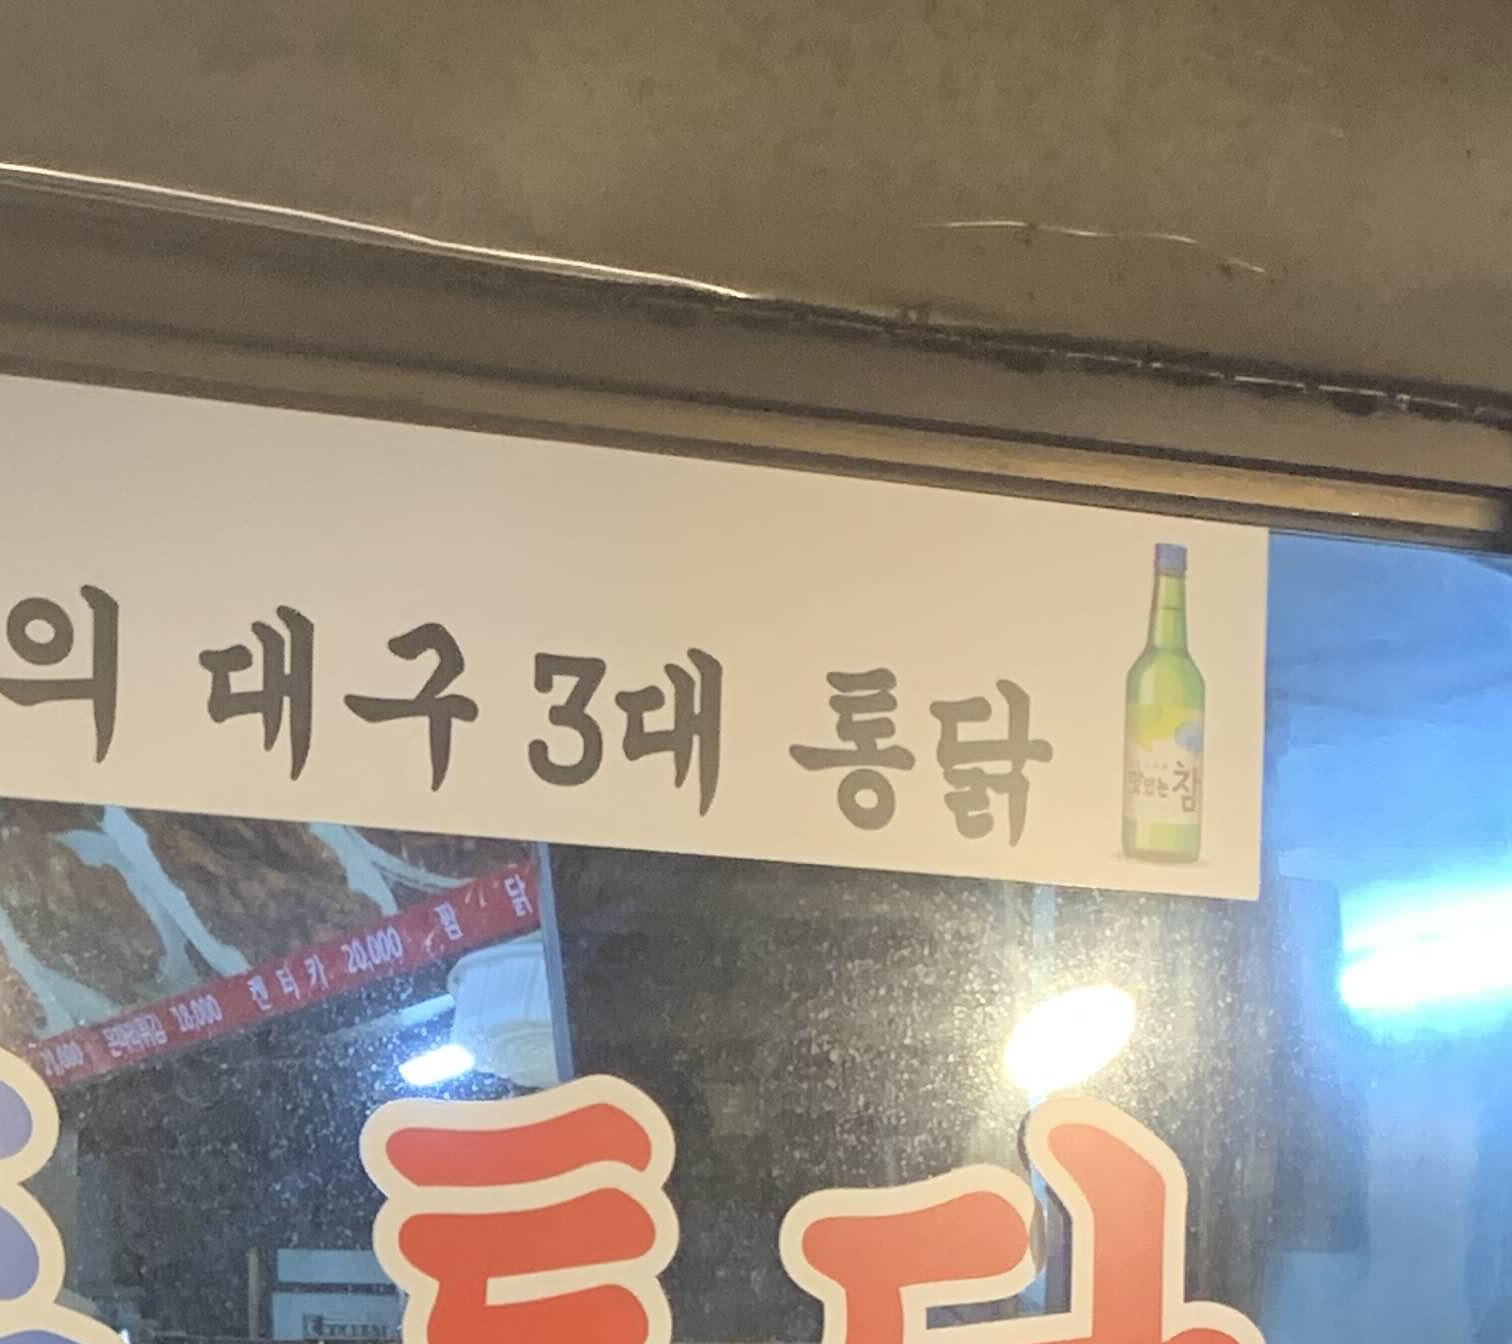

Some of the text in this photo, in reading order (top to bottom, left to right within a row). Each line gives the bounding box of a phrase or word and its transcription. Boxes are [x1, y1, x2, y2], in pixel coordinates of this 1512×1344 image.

[198, 604, 479, 793] 대구
[527, 647, 723, 817] 3대
[787, 666, 1053, 846] 통닭
